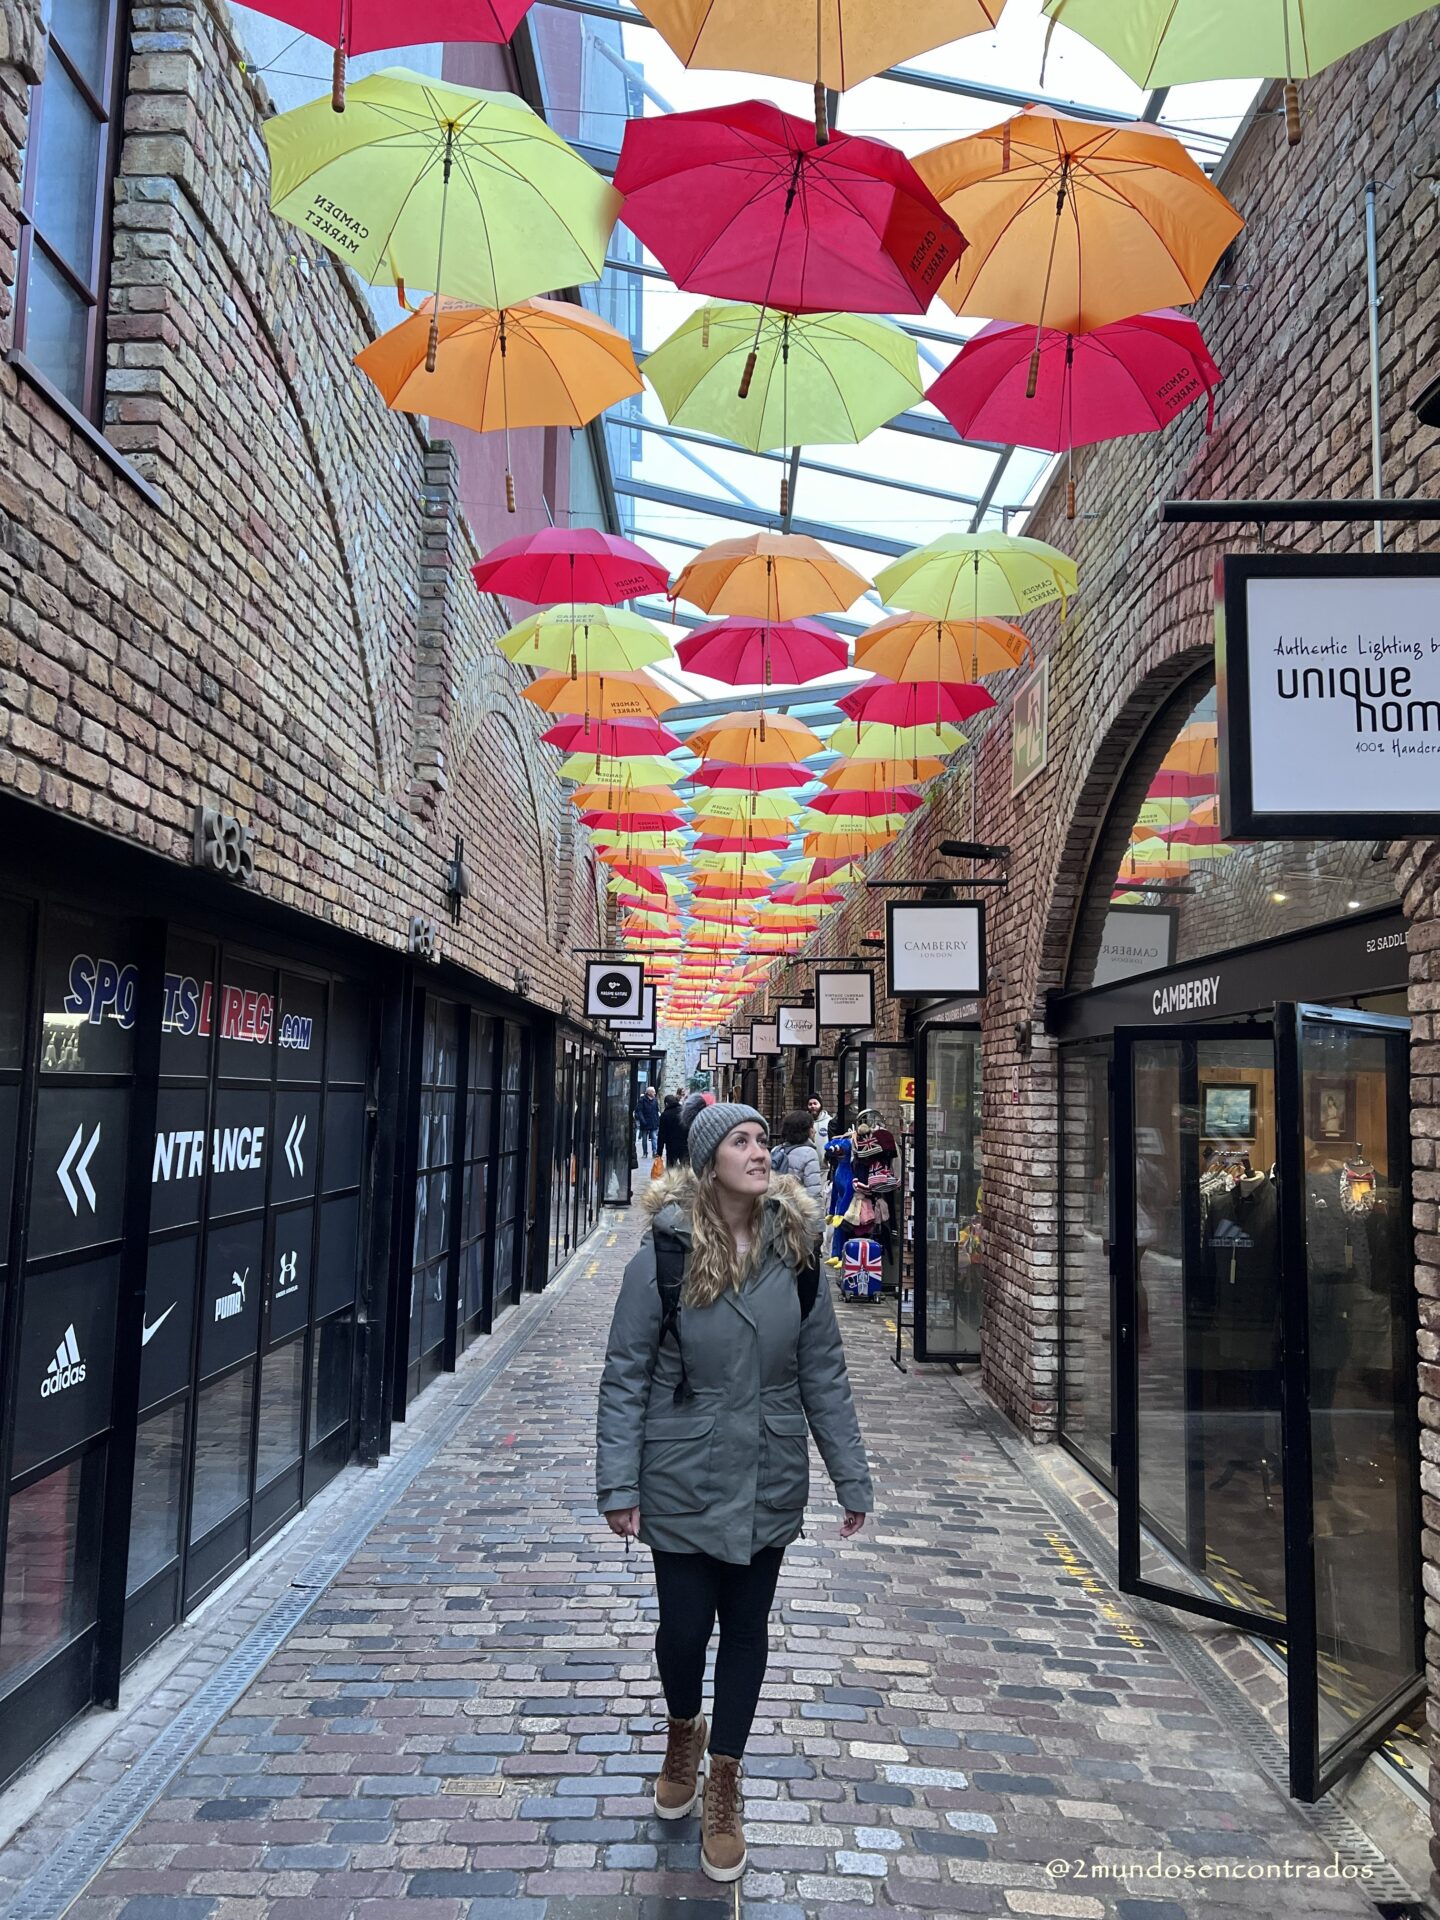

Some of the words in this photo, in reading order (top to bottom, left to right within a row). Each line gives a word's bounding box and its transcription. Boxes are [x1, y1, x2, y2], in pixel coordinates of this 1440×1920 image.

[1273, 635, 1348, 656] Authentic
[1358, 634, 1424, 661] Lighting
[1431, 636, 1440, 653] b
[1355, 694, 1440, 732] hom
[1392, 736, 1440, 758] Handcra
[903, 940, 968, 952] CAMBERRY
[1366, 939, 1376, 953] 52
[1152, 975, 1220, 1016] CAMBERRY
[150, 1127, 265, 1183] NTRANCE
[214, 1291, 243, 1322] PUMA
[40, 1364, 87, 1398] adidas
